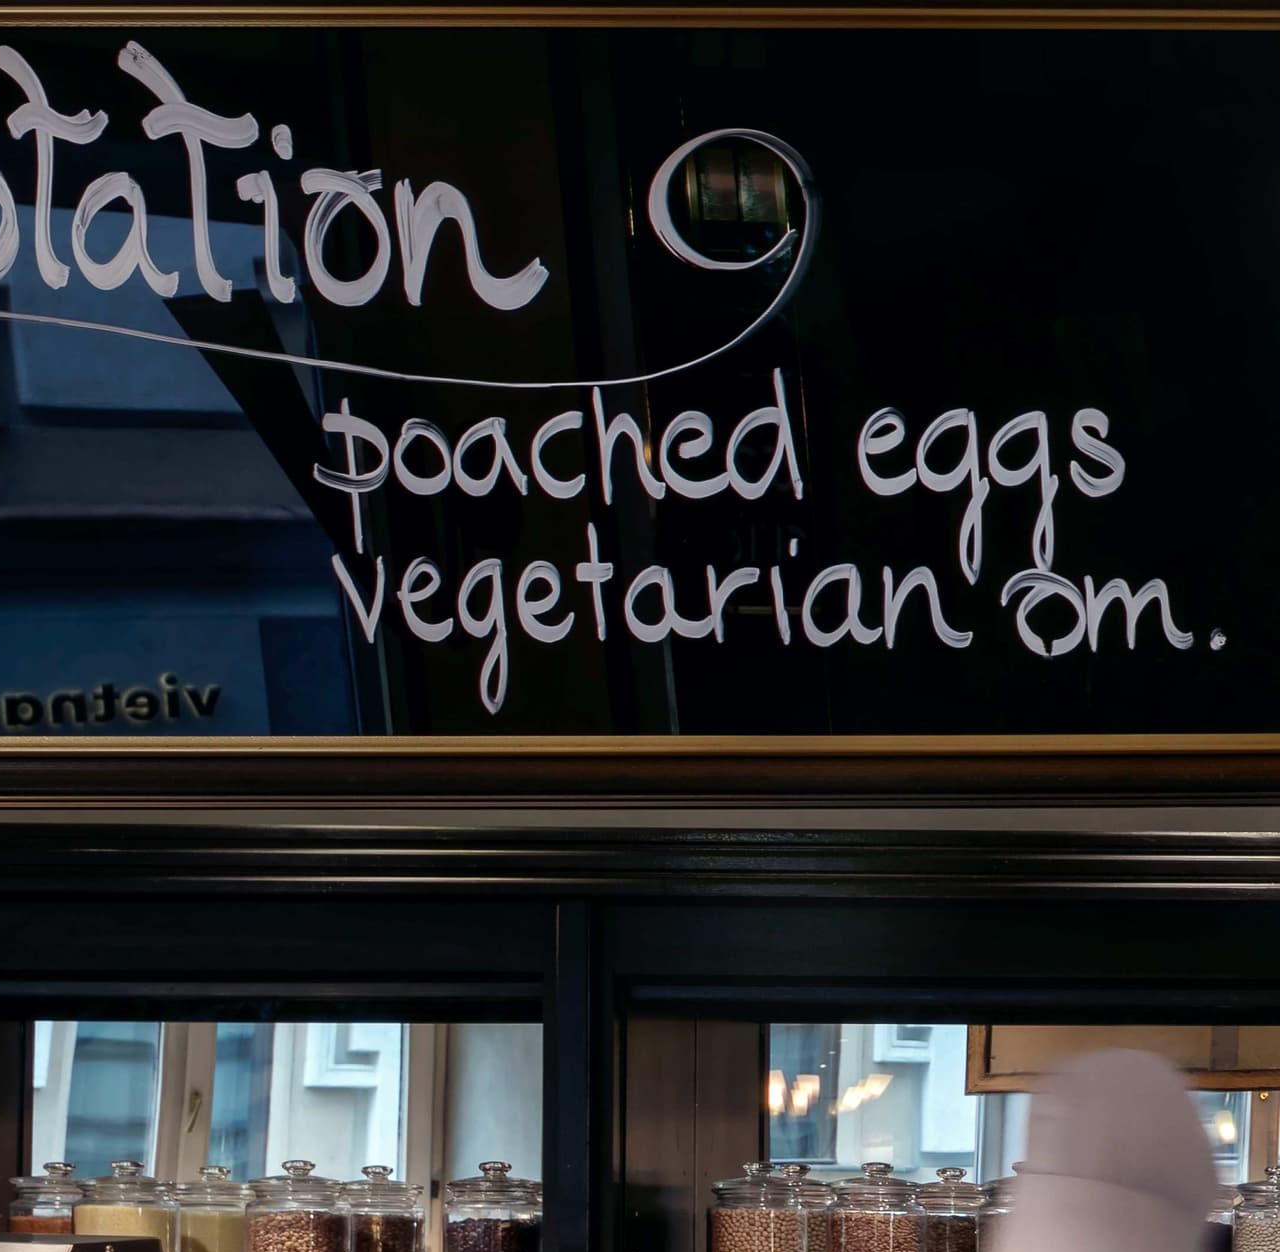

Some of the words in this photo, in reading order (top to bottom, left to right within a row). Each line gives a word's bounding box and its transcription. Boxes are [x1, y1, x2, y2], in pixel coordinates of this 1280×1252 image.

[314, 368, 804, 555] poached
[858, 407, 1126, 585] eggs
[332, 523, 974, 714] vegetarian
[1000, 567, 1227, 657] om.
